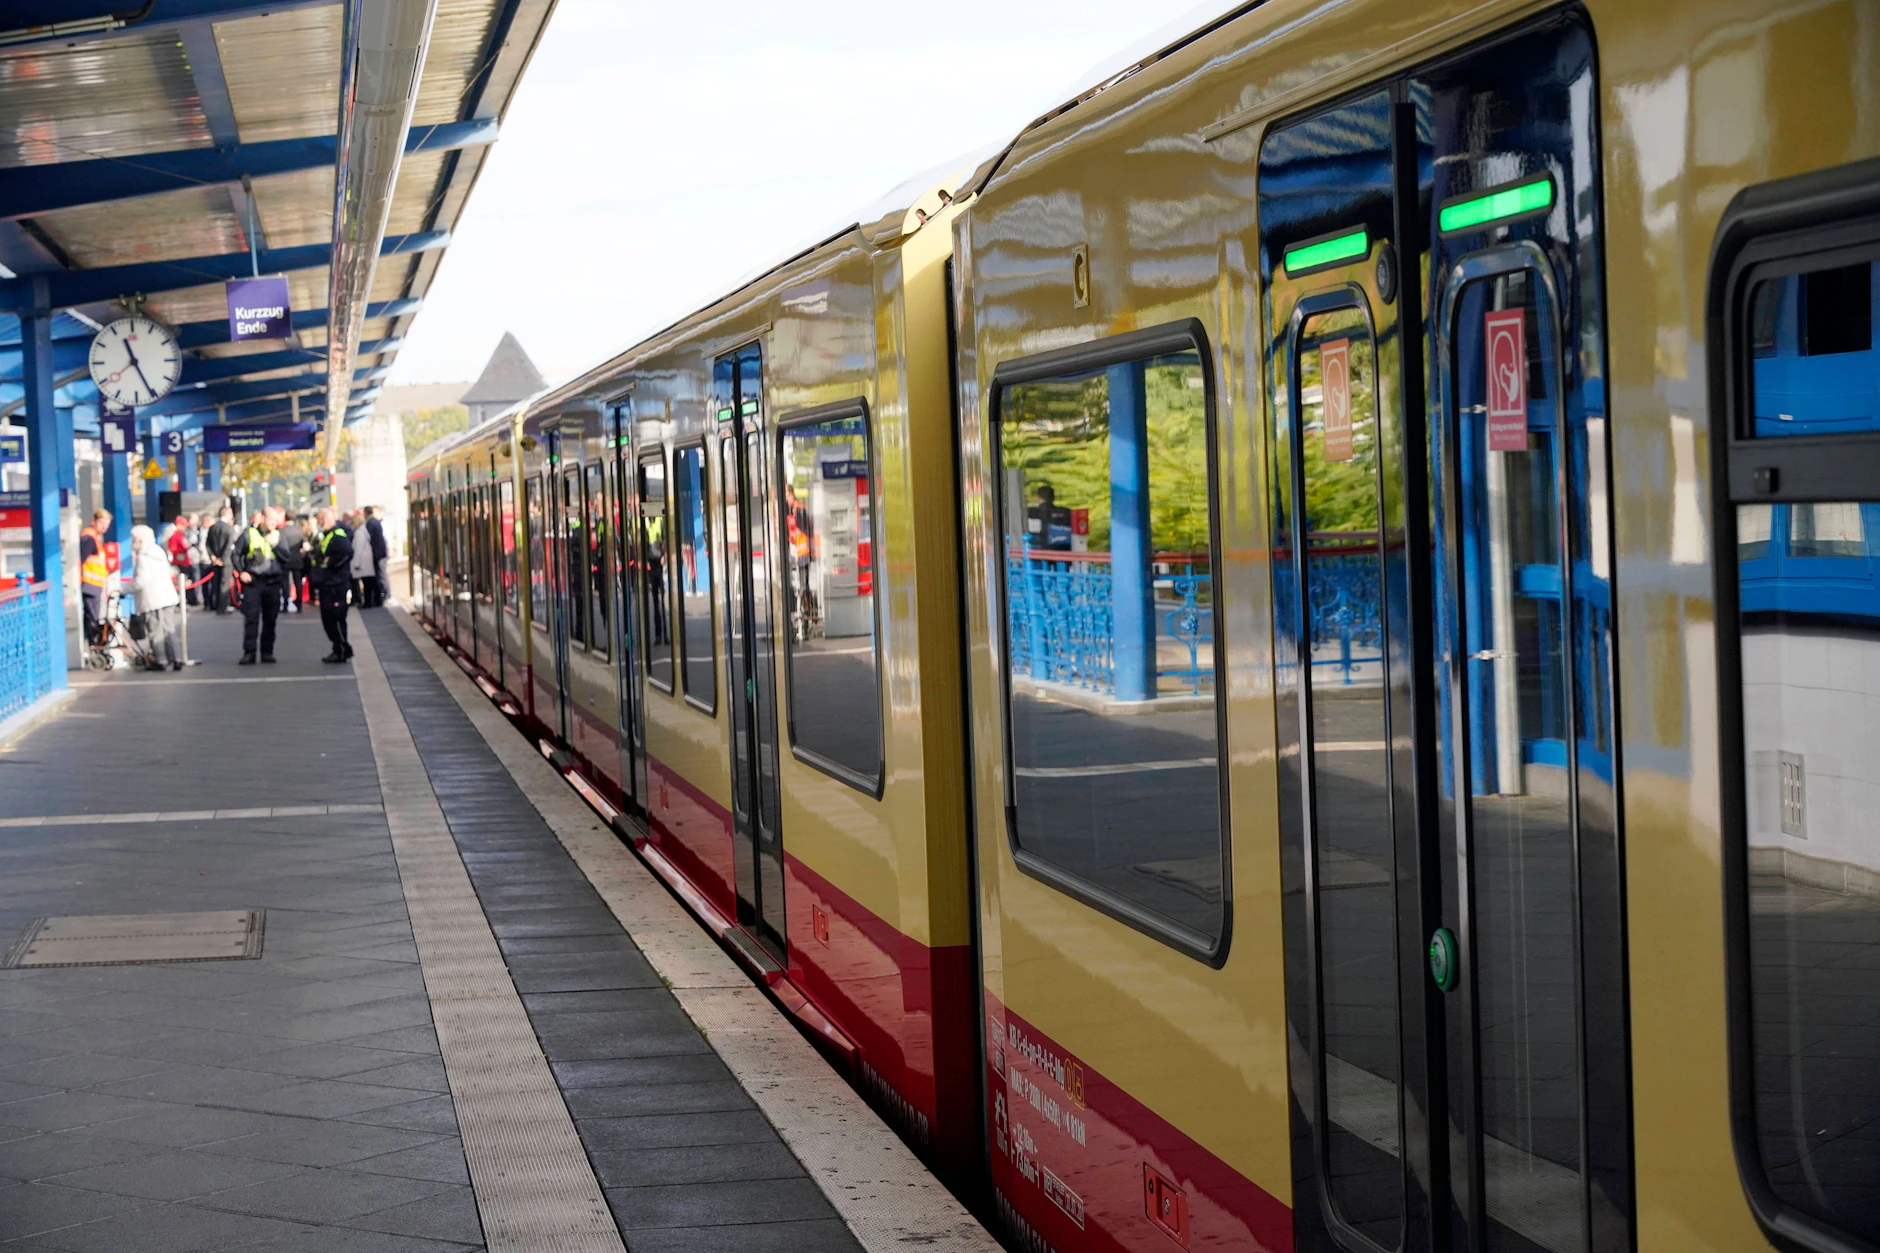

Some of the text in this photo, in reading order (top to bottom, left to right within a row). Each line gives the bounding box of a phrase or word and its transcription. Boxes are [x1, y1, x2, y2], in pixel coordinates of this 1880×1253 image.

[235, 306, 284, 320] Kurzzug
[237, 321, 267, 335] Ende
[168, 431, 182, 453] 3
